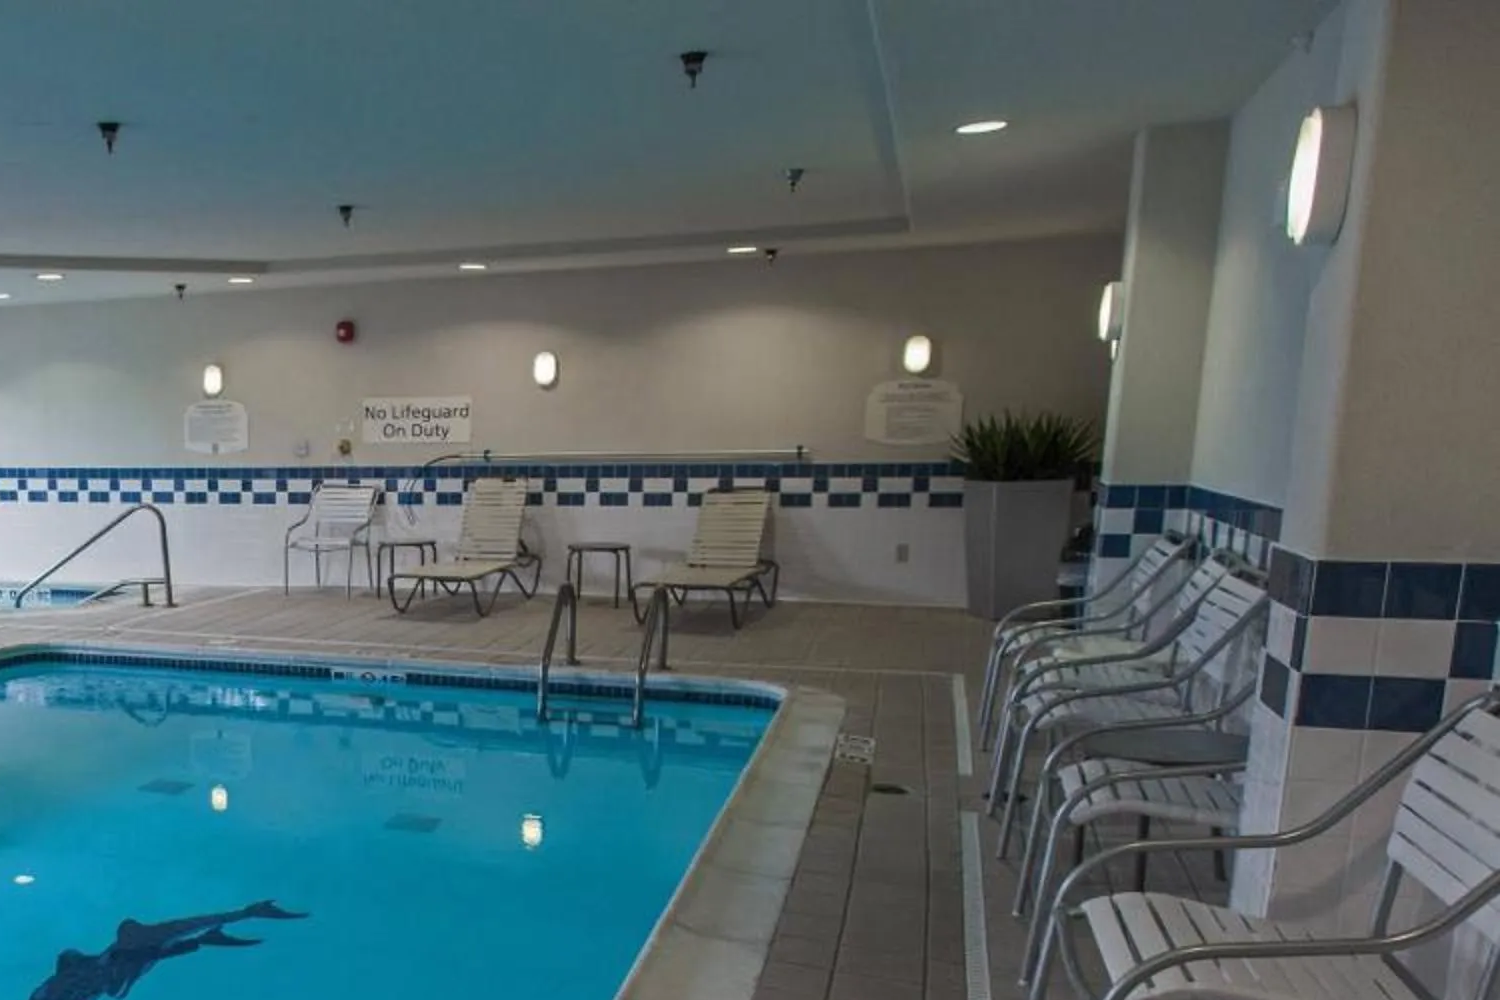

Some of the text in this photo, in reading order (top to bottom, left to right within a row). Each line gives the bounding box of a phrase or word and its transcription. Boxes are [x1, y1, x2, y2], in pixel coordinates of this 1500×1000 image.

[364, 403, 469, 422] No Lifeguard
[382, 423, 450, 441] On Duty
